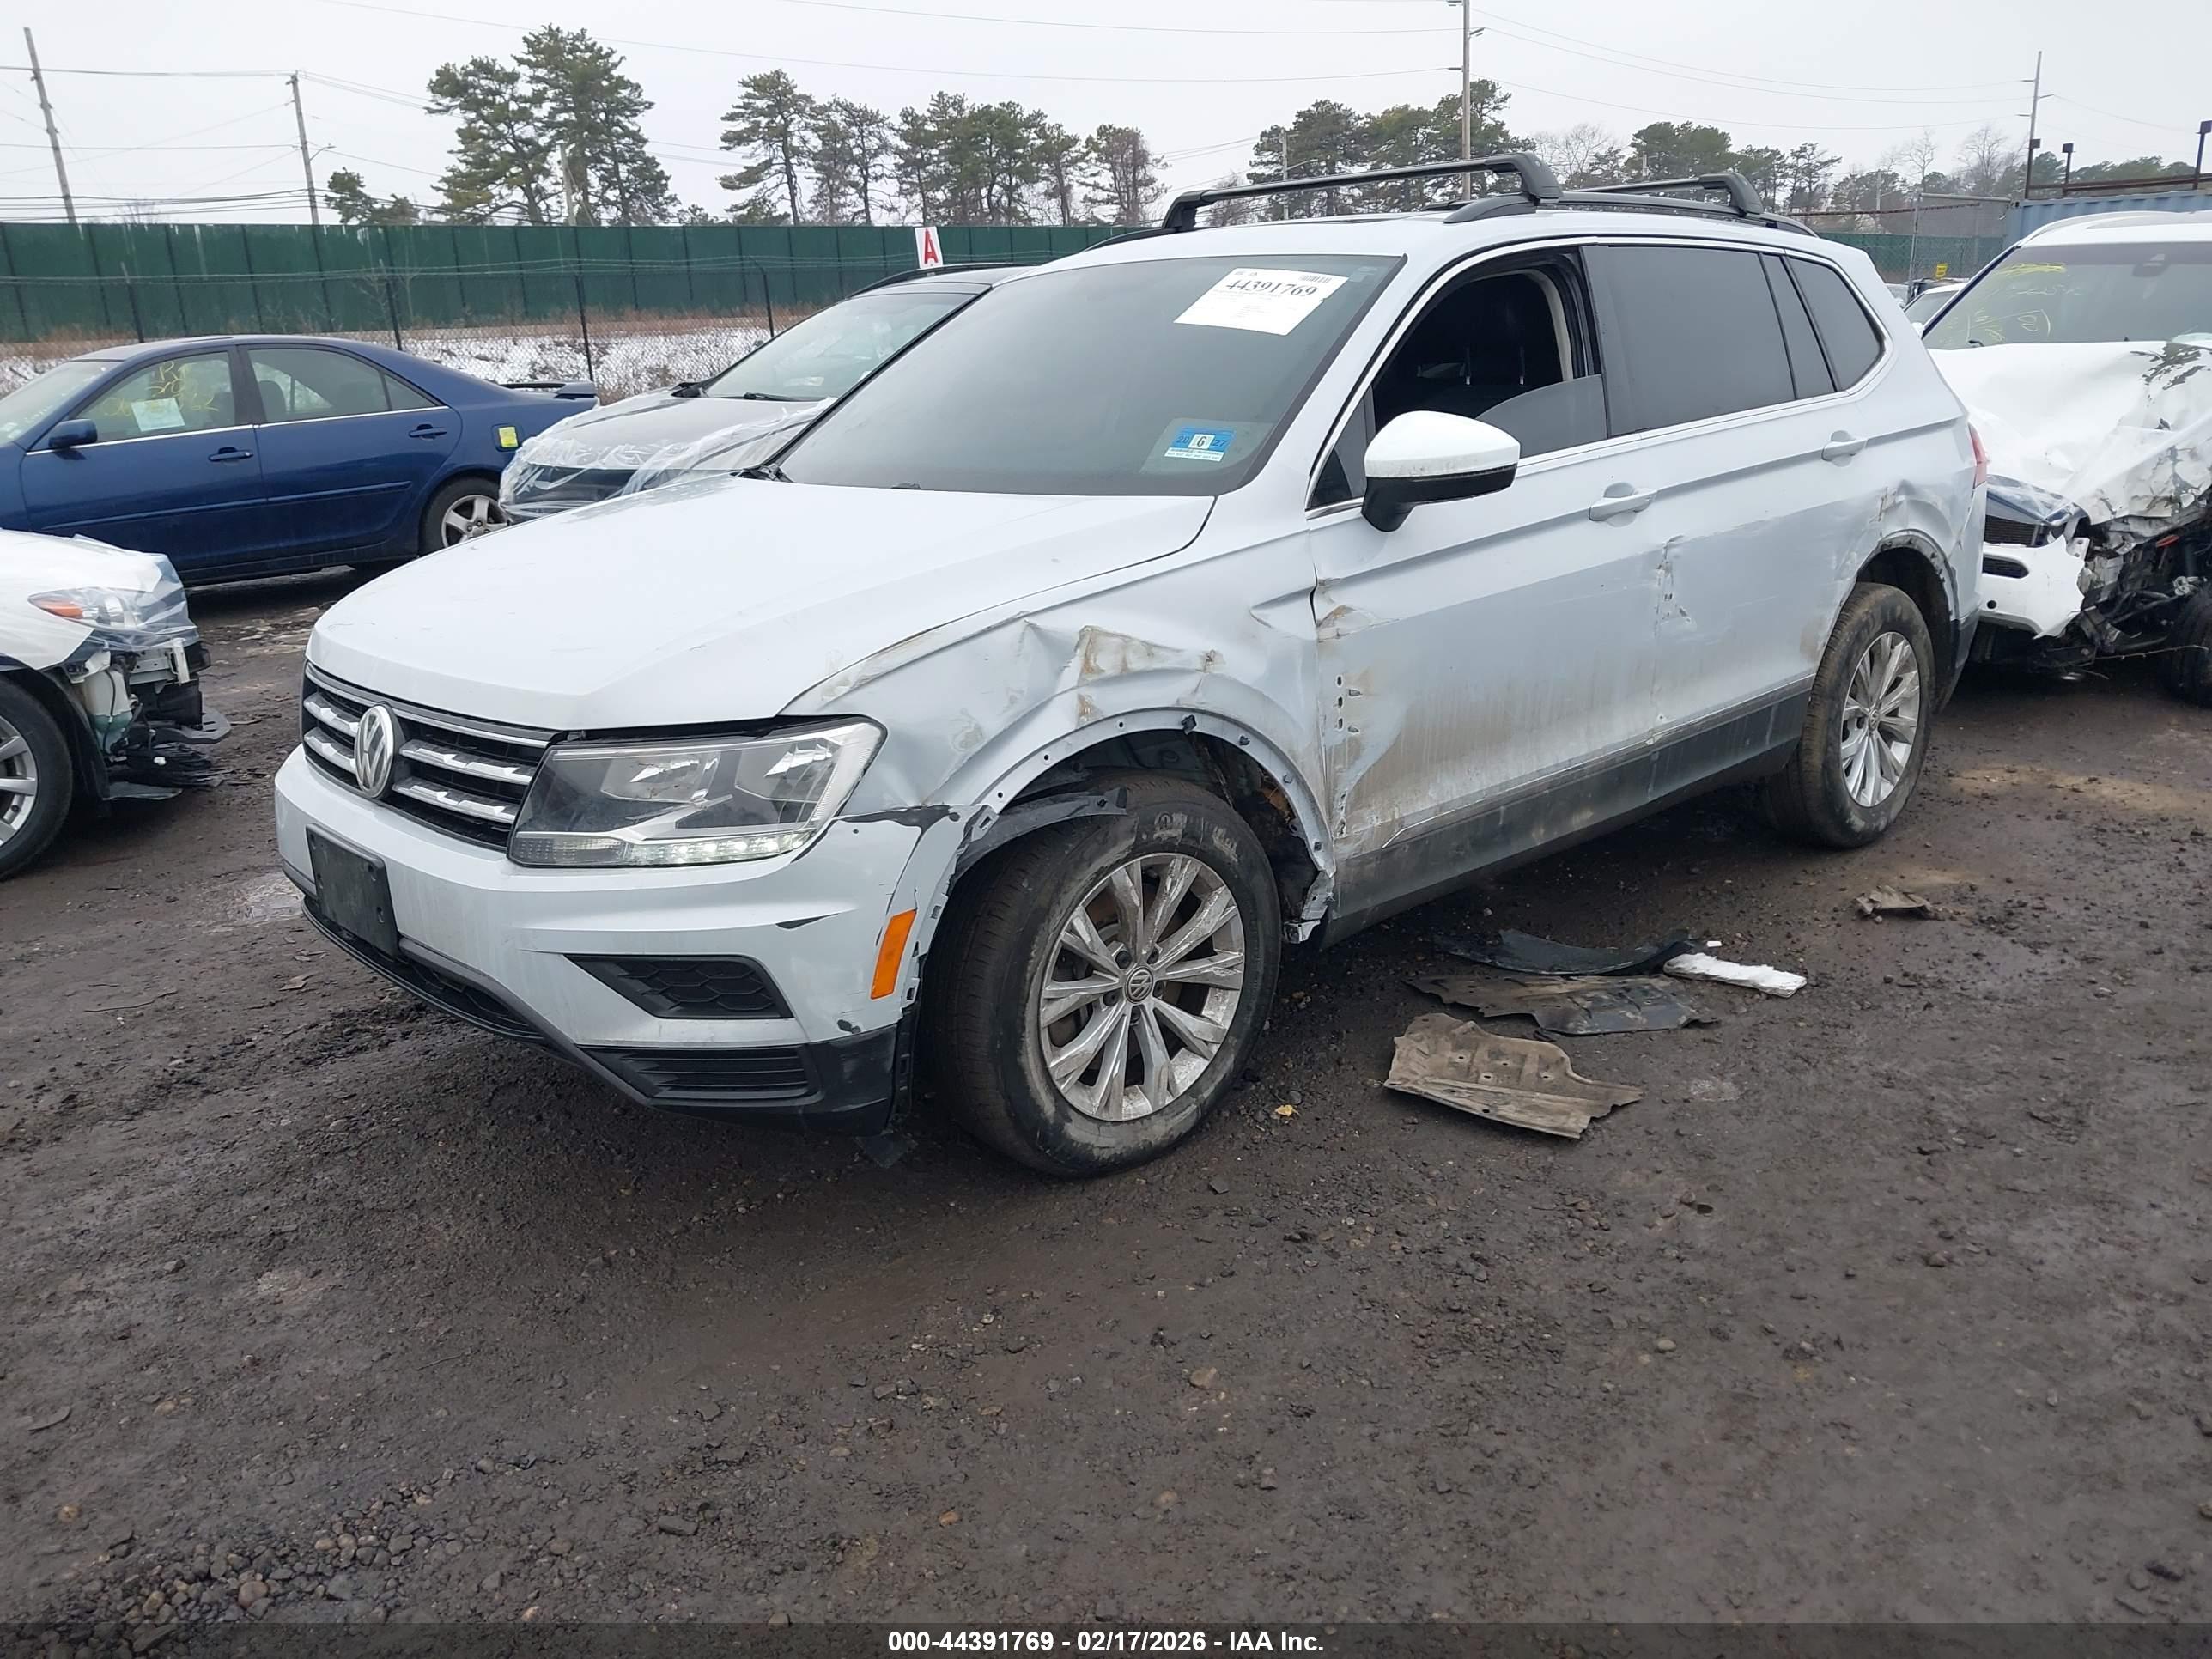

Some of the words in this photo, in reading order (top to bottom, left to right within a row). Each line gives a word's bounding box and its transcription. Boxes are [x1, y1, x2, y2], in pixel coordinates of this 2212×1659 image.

[924, 228, 939, 264] A
[1225, 279, 1318, 297] 44391769
[1196, 435, 1206, 447] 6
